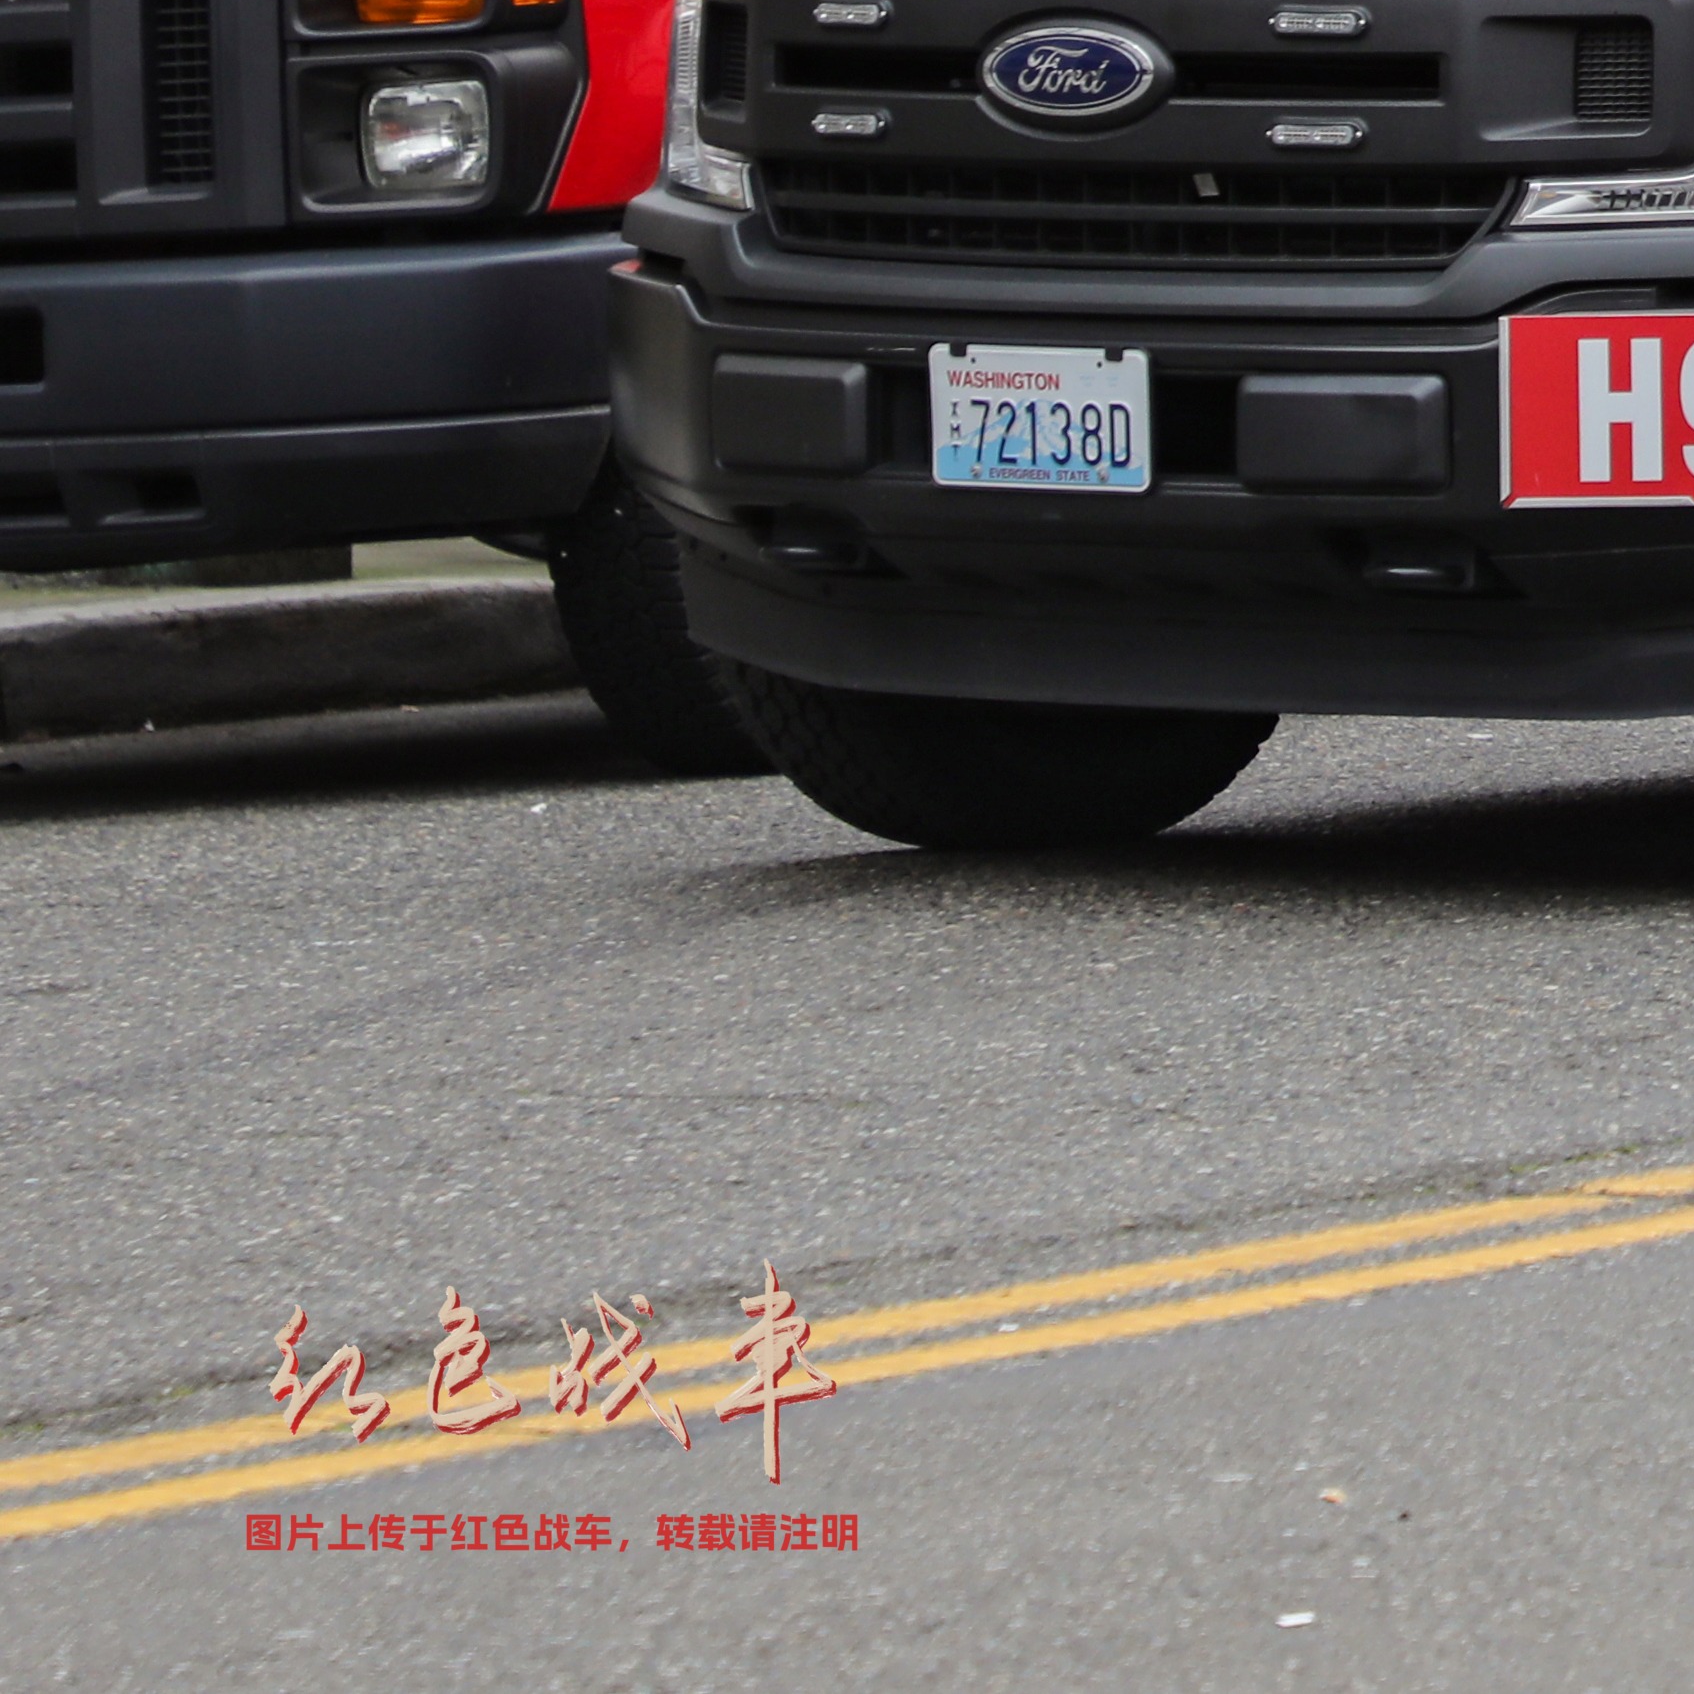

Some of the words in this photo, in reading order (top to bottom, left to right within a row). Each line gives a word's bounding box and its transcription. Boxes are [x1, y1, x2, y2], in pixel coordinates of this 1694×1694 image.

[1018, 46, 1111, 94] Ford
[946, 369, 1061, 391] WASHINGTON
[970, 398, 1132, 468] 72138D
[988, 467, 1051, 481] EVERGREEN
[1055, 469, 1091, 483] STATE
